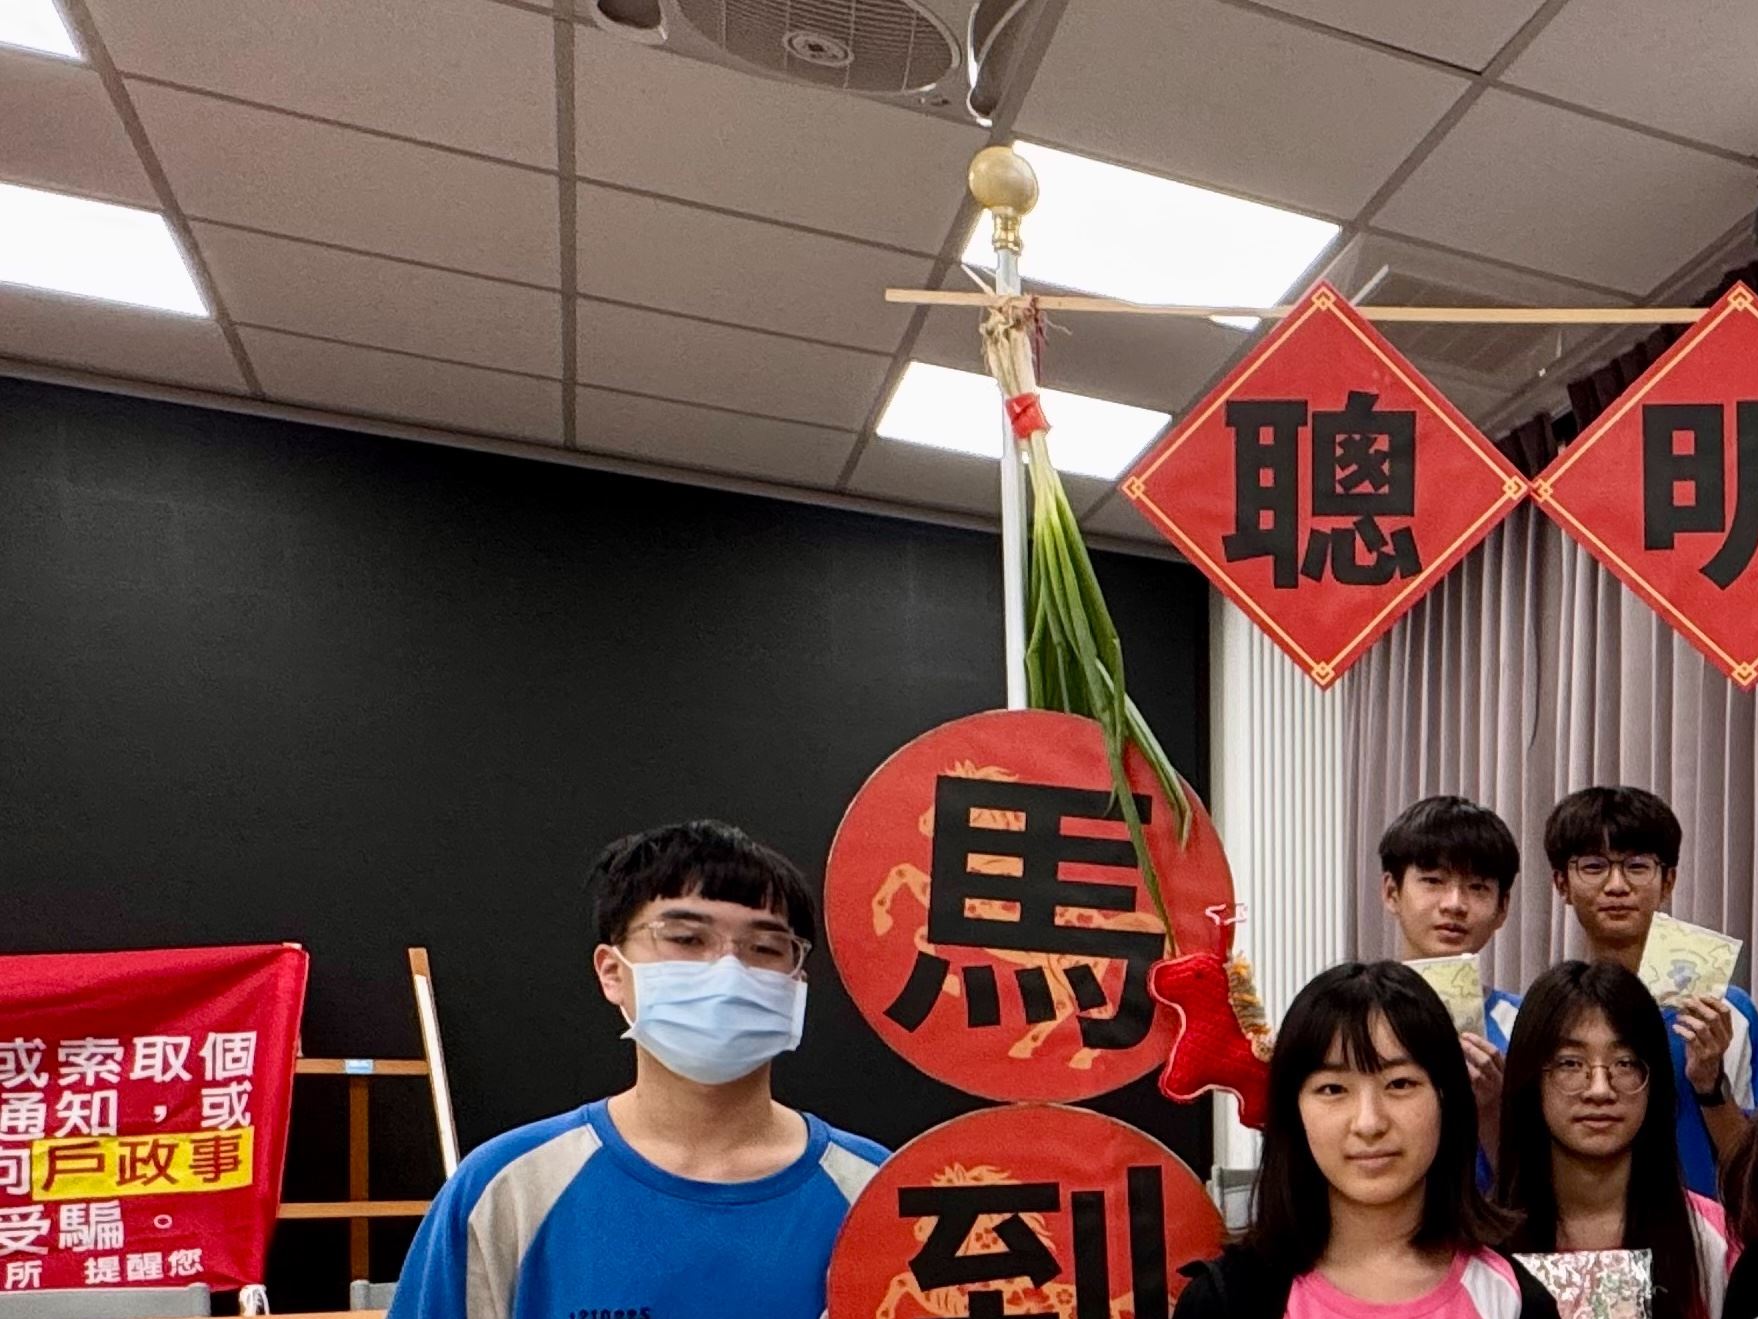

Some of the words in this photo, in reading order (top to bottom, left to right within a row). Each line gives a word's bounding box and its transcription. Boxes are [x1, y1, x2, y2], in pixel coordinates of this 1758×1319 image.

[0, 1031, 257, 1088] 或索取個
[84, 1249, 203, 1285] 提醒您
